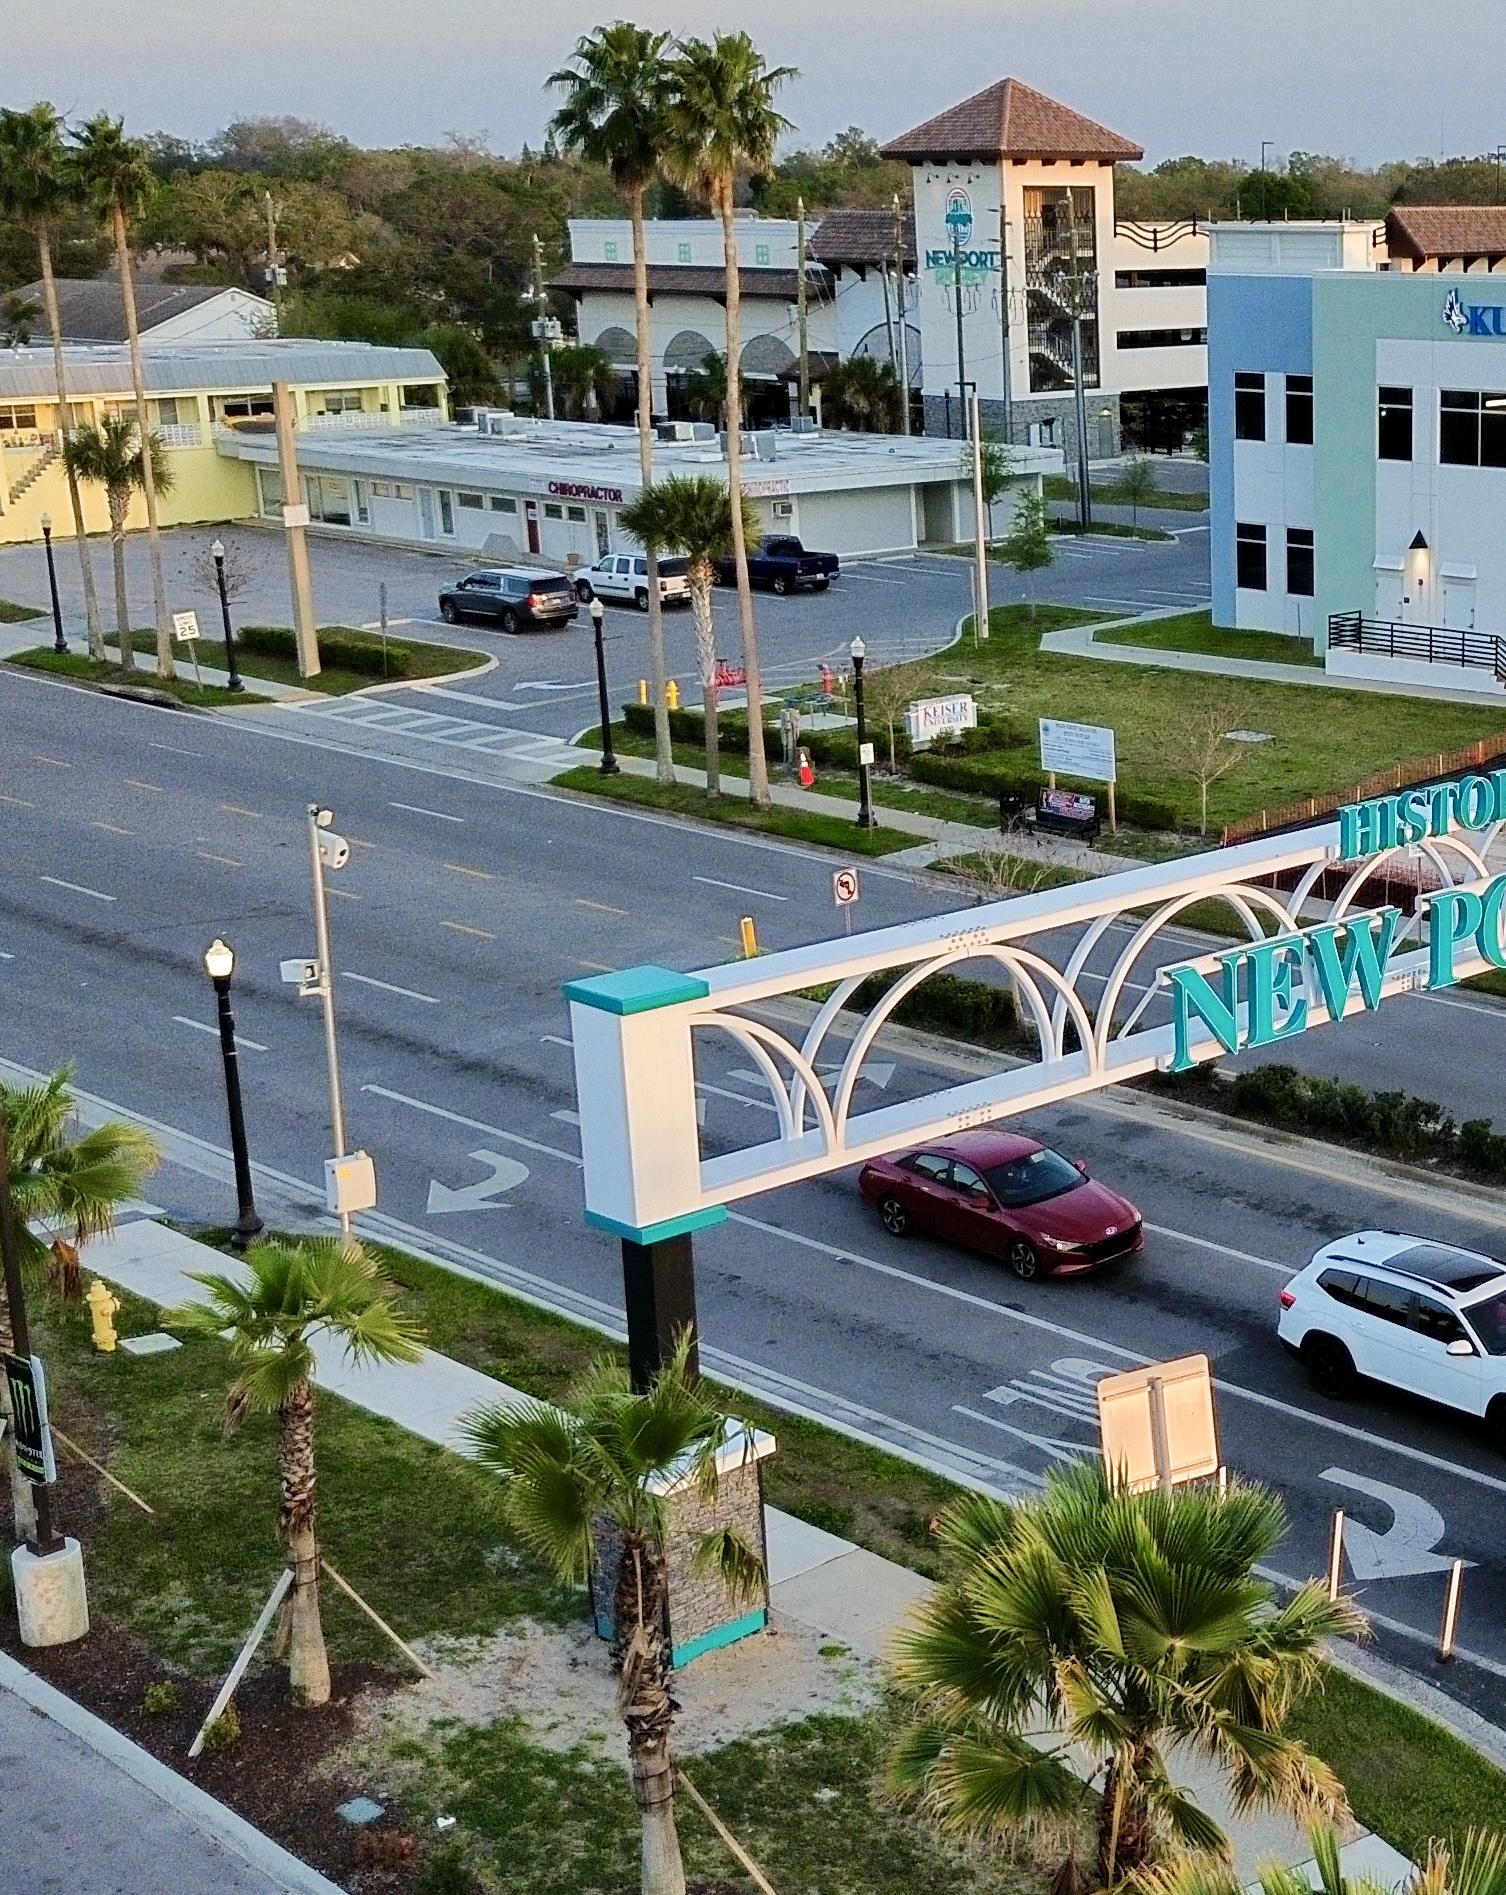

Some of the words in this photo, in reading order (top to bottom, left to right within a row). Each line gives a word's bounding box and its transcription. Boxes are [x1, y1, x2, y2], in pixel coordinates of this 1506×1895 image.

[959, 250, 999, 268] PORT
[548, 480, 623, 502] CHIROPRACTOR
[180, 625, 196, 637] 25
[924, 701, 968, 719] KEISER
[1164, 907, 1402, 1072] NEW
